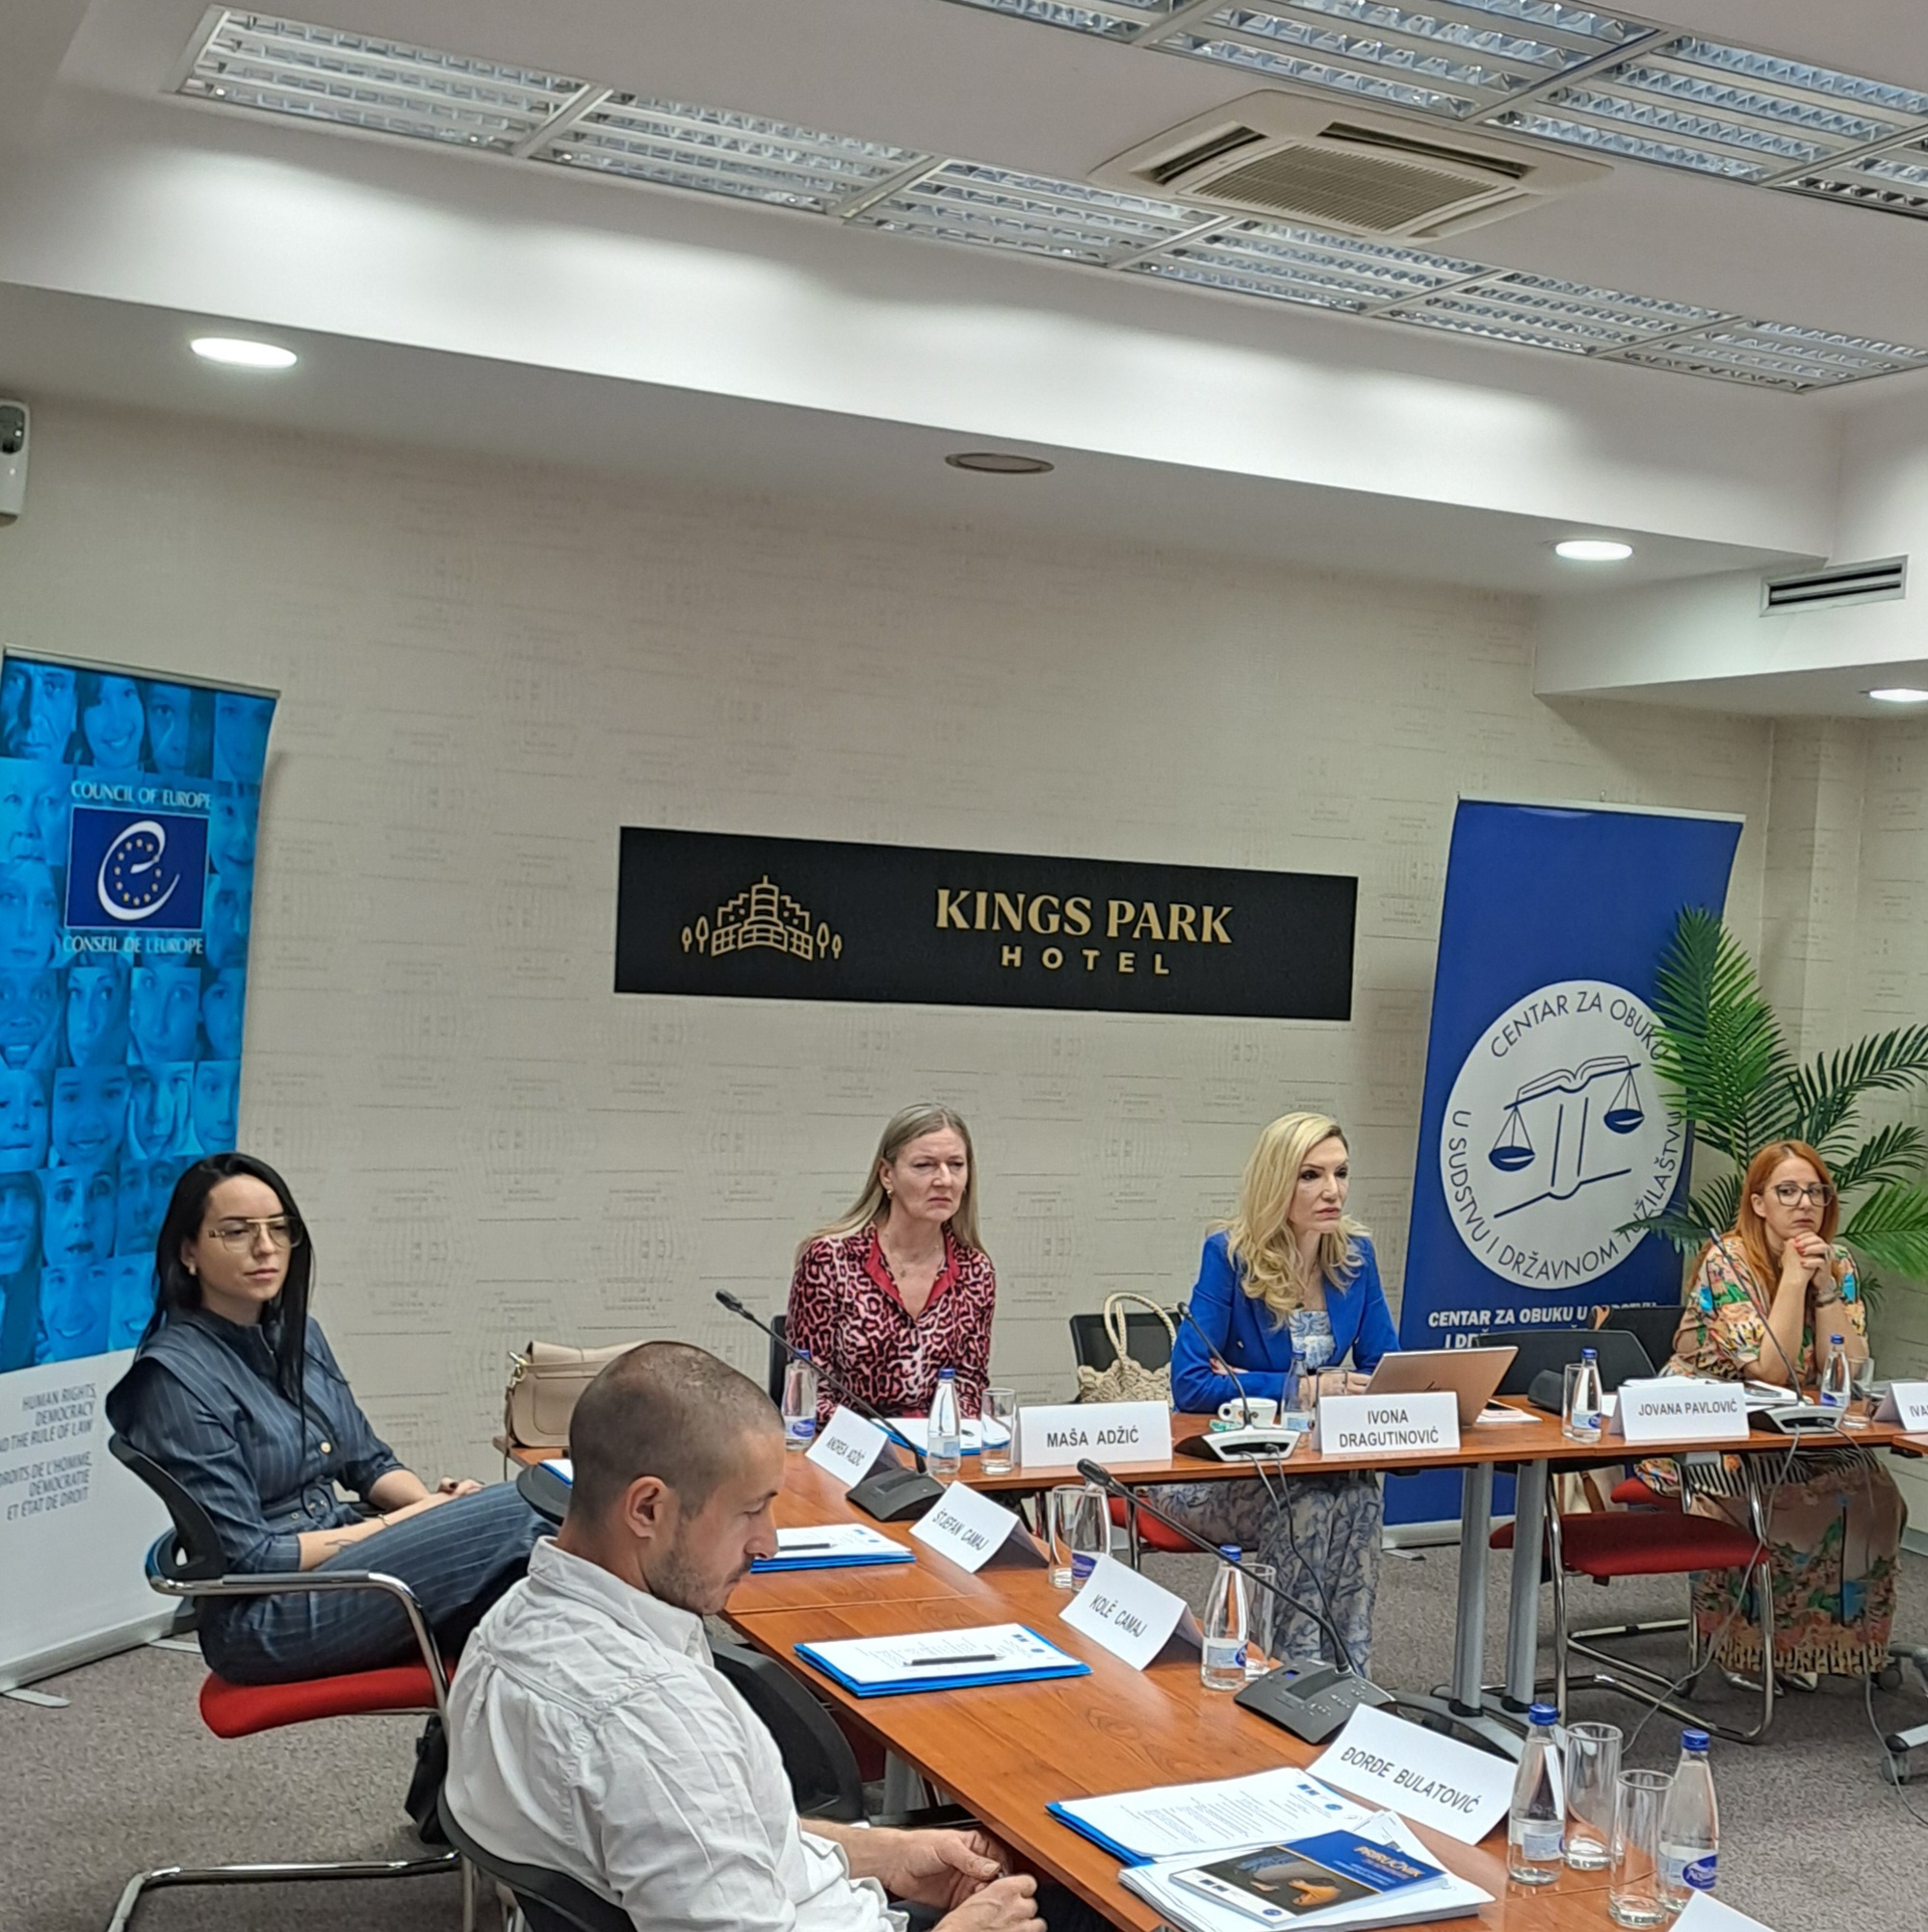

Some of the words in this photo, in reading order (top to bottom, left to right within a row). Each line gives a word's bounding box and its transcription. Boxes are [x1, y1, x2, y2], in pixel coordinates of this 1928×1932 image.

[70, 780, 135, 802] COUNCIL
[138, 786, 158, 804] OF
[162, 789, 211, 810] EUROPE
[935, 888, 1092, 936] KINGS
[1107, 899, 1234, 944] PARK
[63, 934, 119, 953] CONSEIL
[123, 935, 143, 953] DE
[1001, 944, 1170, 975] HOTEL
[1491, 994, 1570, 1057] CENTAR
[1576, 991, 1602, 1012] ZA
[1610, 999, 1670, 1060] OBUKU
[1452, 1110, 1472, 1127] U
[1448, 1137, 1491, 1242] SUDSTVU
[1486, 1237, 1499, 1254] I
[1498, 1239, 1619, 1281] DRŽAVNOM
[1428, 1309, 1492, 1327] CENTAR
[1494, 1308, 1516, 1324] ZA
[1519, 1306, 1574, 1323] OBUKU
[1576, 1305, 1588, 1320] U
[22, 1390, 60, 1411] HUMAN
[62, 1383, 96, 1403] RIGHTS
[1638, 1402, 1682, 1416] JOVANA
[1684, 1397, 1737, 1414] PAVLOVIĆ
[35, 1400, 95, 1426] DEMOCRACY
[1368, 1409, 1409, 1425] IVONA
[31, 1426, 55, 1445] RULE
[57, 1422, 70, 1440] OF
[71, 1419, 93, 1436] LAW
[1047, 1427, 1089, 1448] MAŠA
[1096, 1424, 1140, 1445] ADŽIĆ
[1339, 1425, 1439, 1448] DRAGUTINOVIĆ
[32, 1462, 44, 1478] DE
[45, 1494, 58, 1511] DE
[960, 1528, 990, 1551] CAMAJ
[1114, 1610, 1148, 1638] CAMAJ
[1341, 1746, 1394, 1779] ĐORĐE
[1393, 1768, 1483, 1815] BULATOVIĆ
